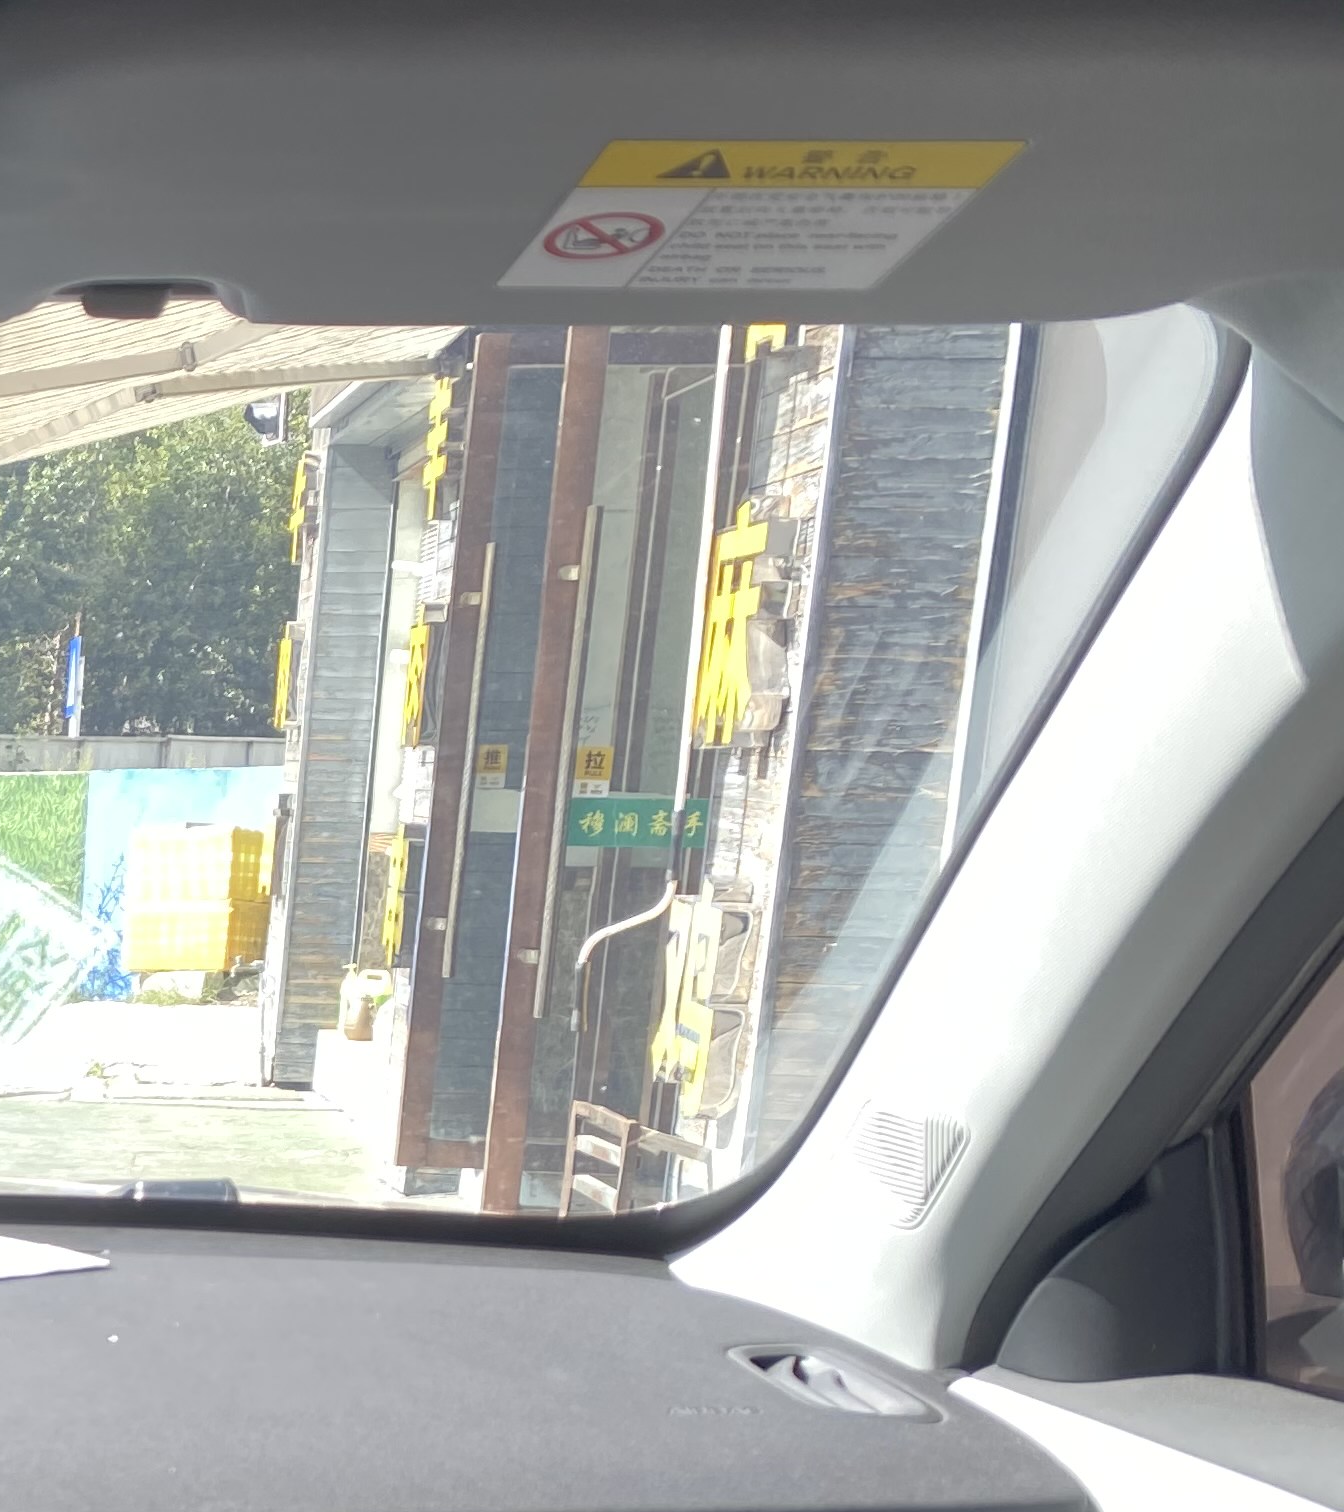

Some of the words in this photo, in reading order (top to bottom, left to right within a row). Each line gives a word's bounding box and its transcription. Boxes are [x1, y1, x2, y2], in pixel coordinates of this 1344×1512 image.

[743, 165, 918, 181] WARNING
[483, 748, 501, 765] 推
[584, 749, 606, 770] 拉
